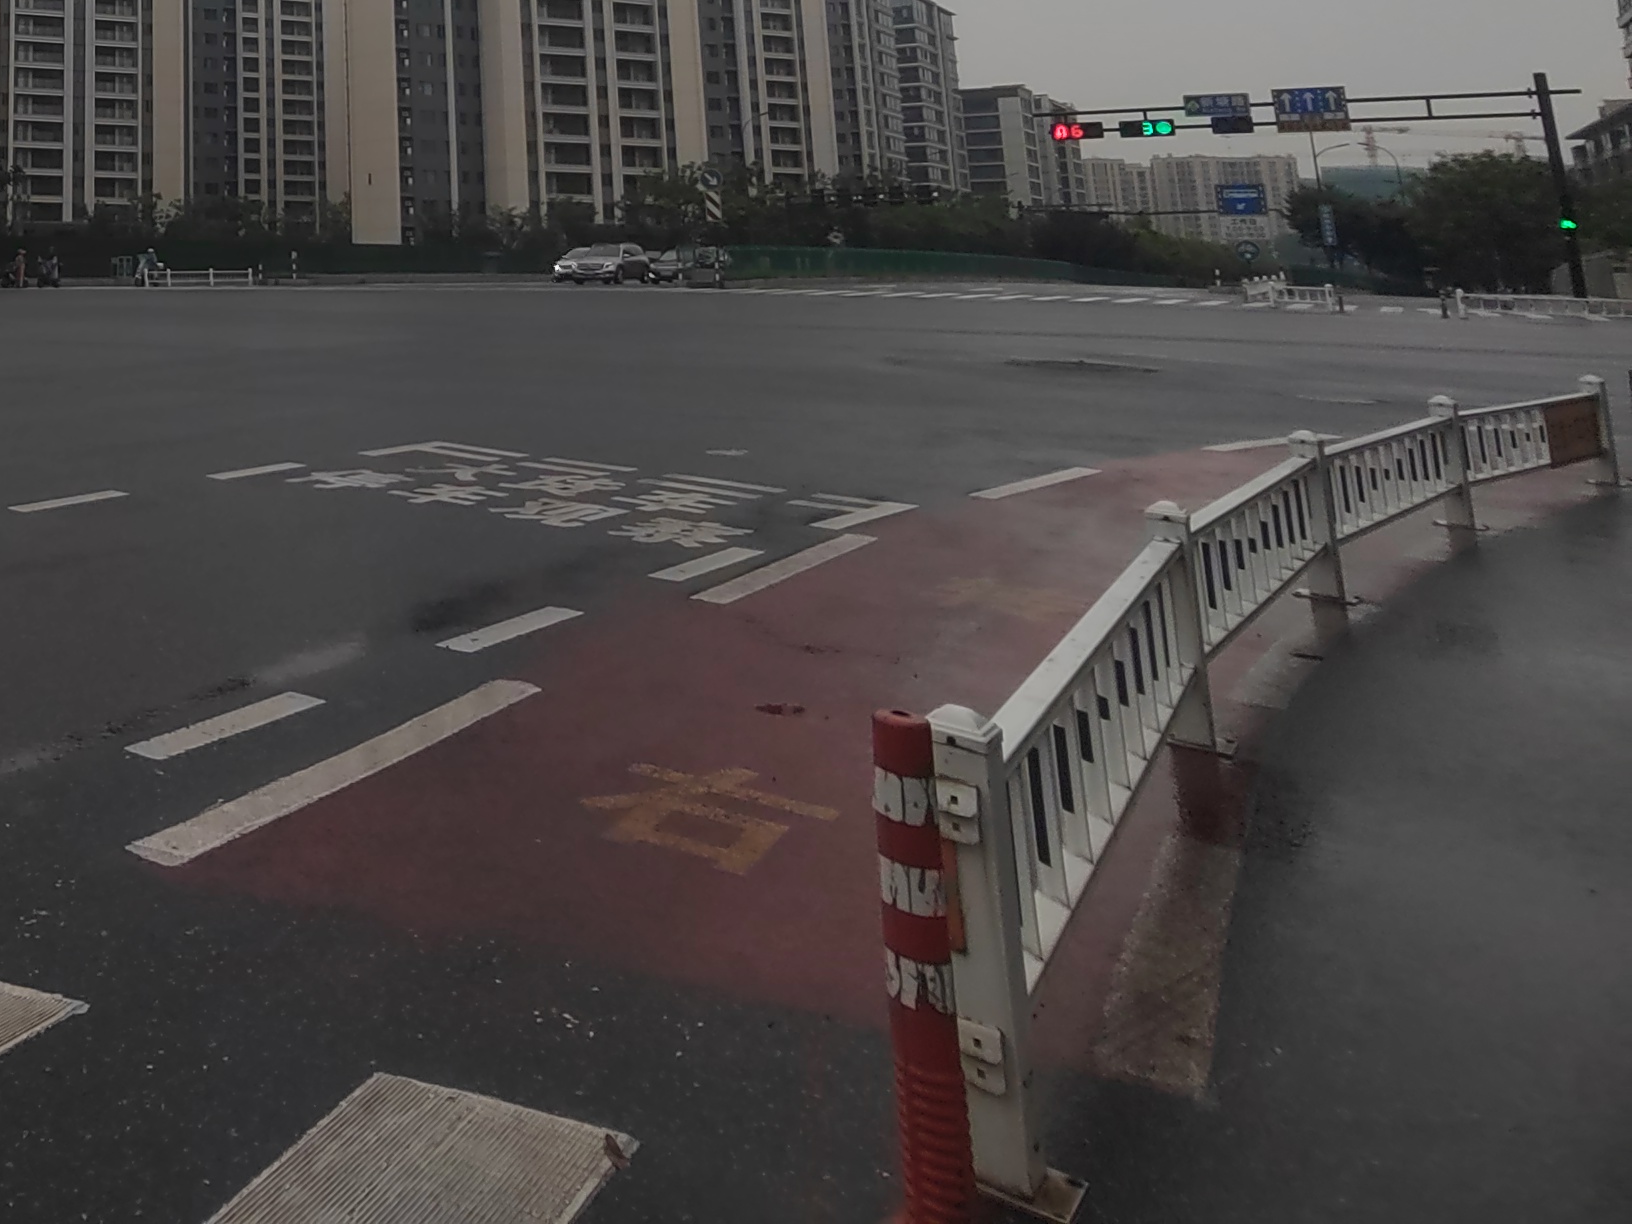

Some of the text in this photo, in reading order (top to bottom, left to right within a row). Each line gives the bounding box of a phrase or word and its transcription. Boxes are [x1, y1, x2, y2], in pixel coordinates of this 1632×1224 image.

[285, 469, 755, 547] 停车观察
[579, 762, 842, 875] 右
